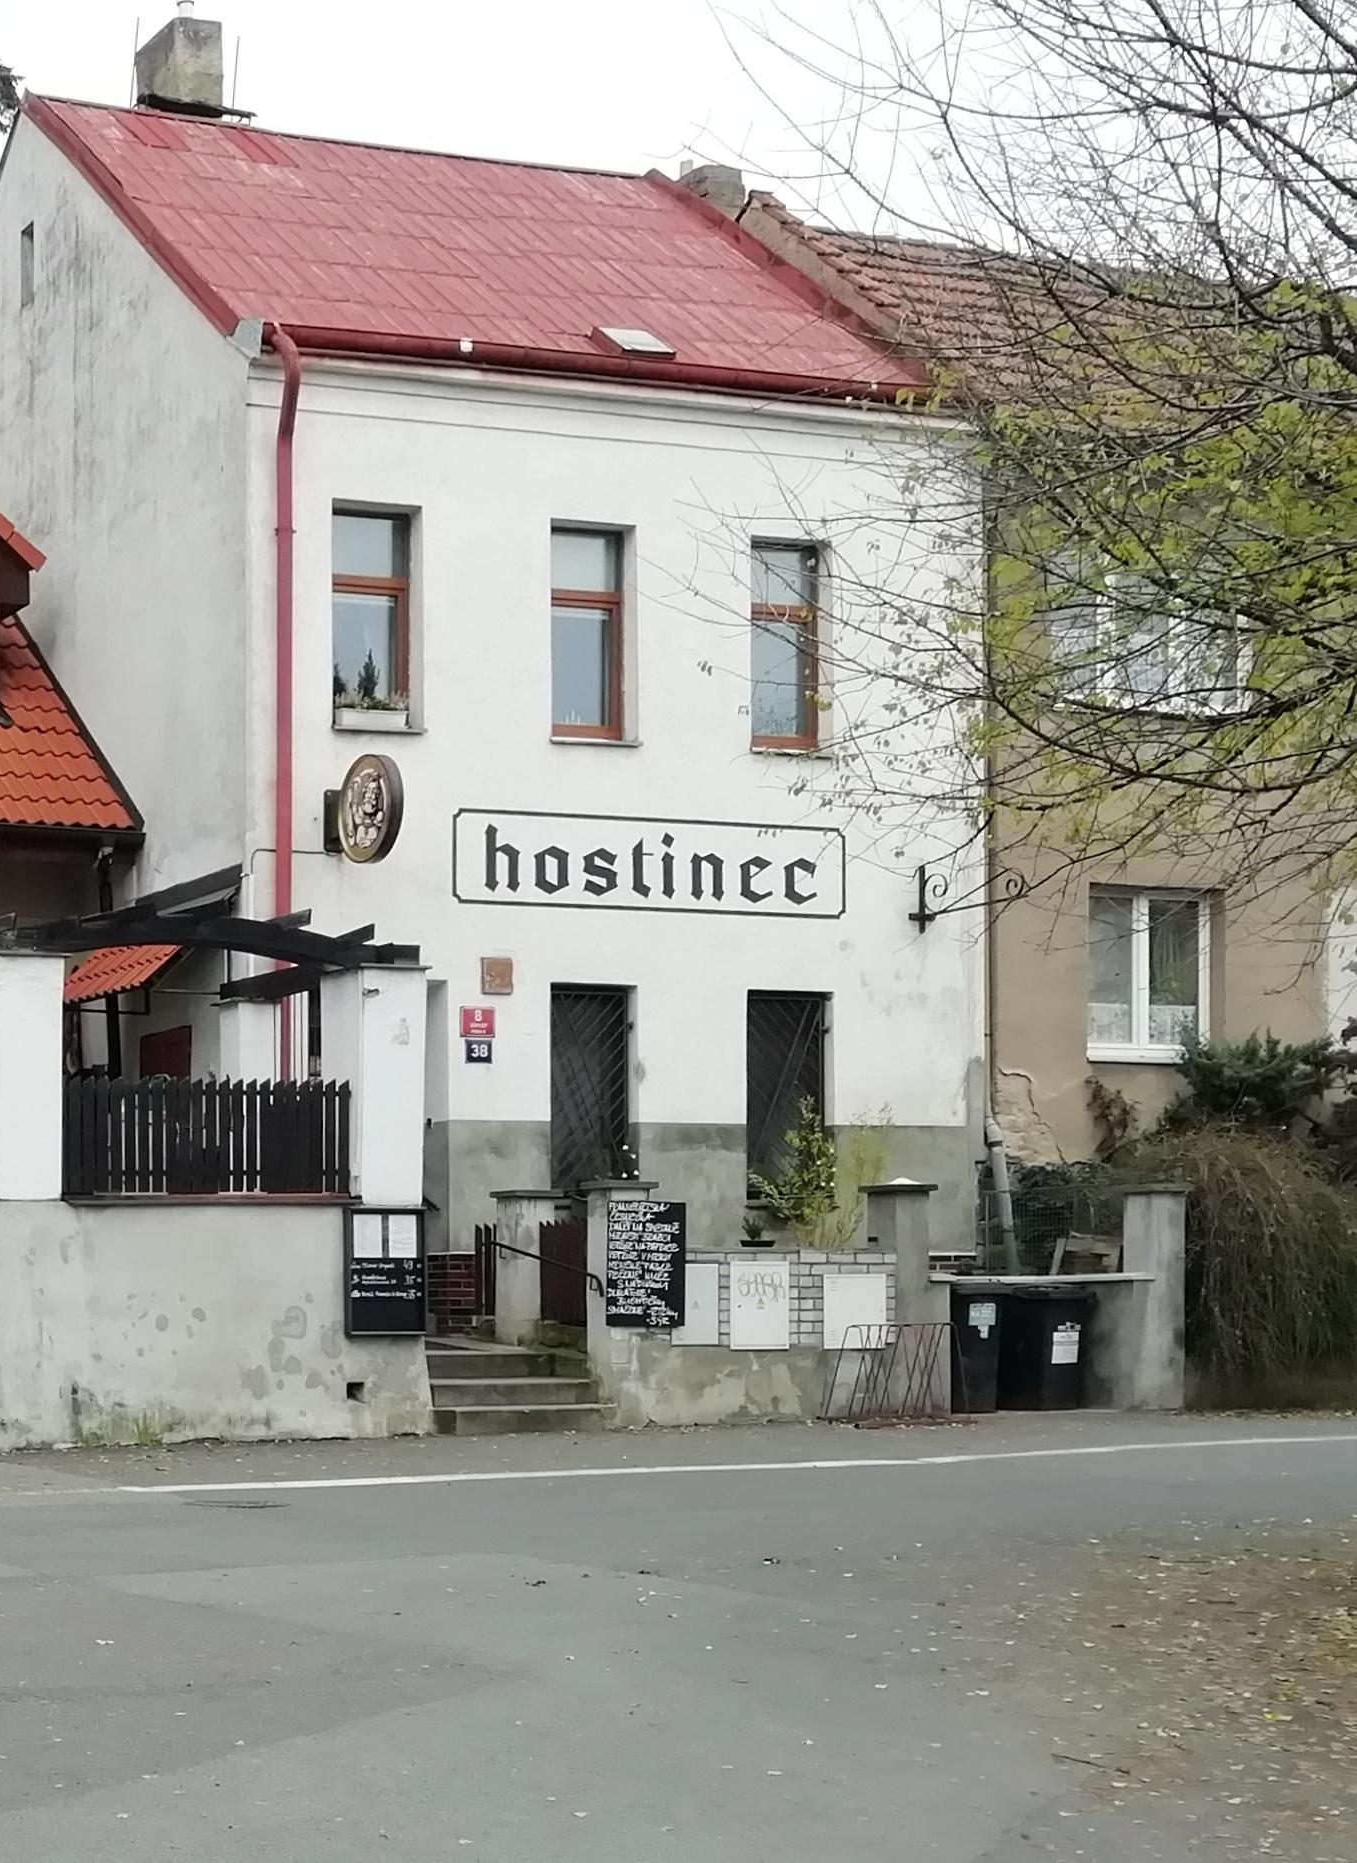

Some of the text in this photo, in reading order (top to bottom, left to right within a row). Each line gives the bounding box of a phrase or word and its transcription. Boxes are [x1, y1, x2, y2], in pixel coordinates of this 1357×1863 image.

[484, 822, 818, 906] hostinec
[474, 1009, 483, 1022] 8
[470, 1043, 489, 1058] 38
